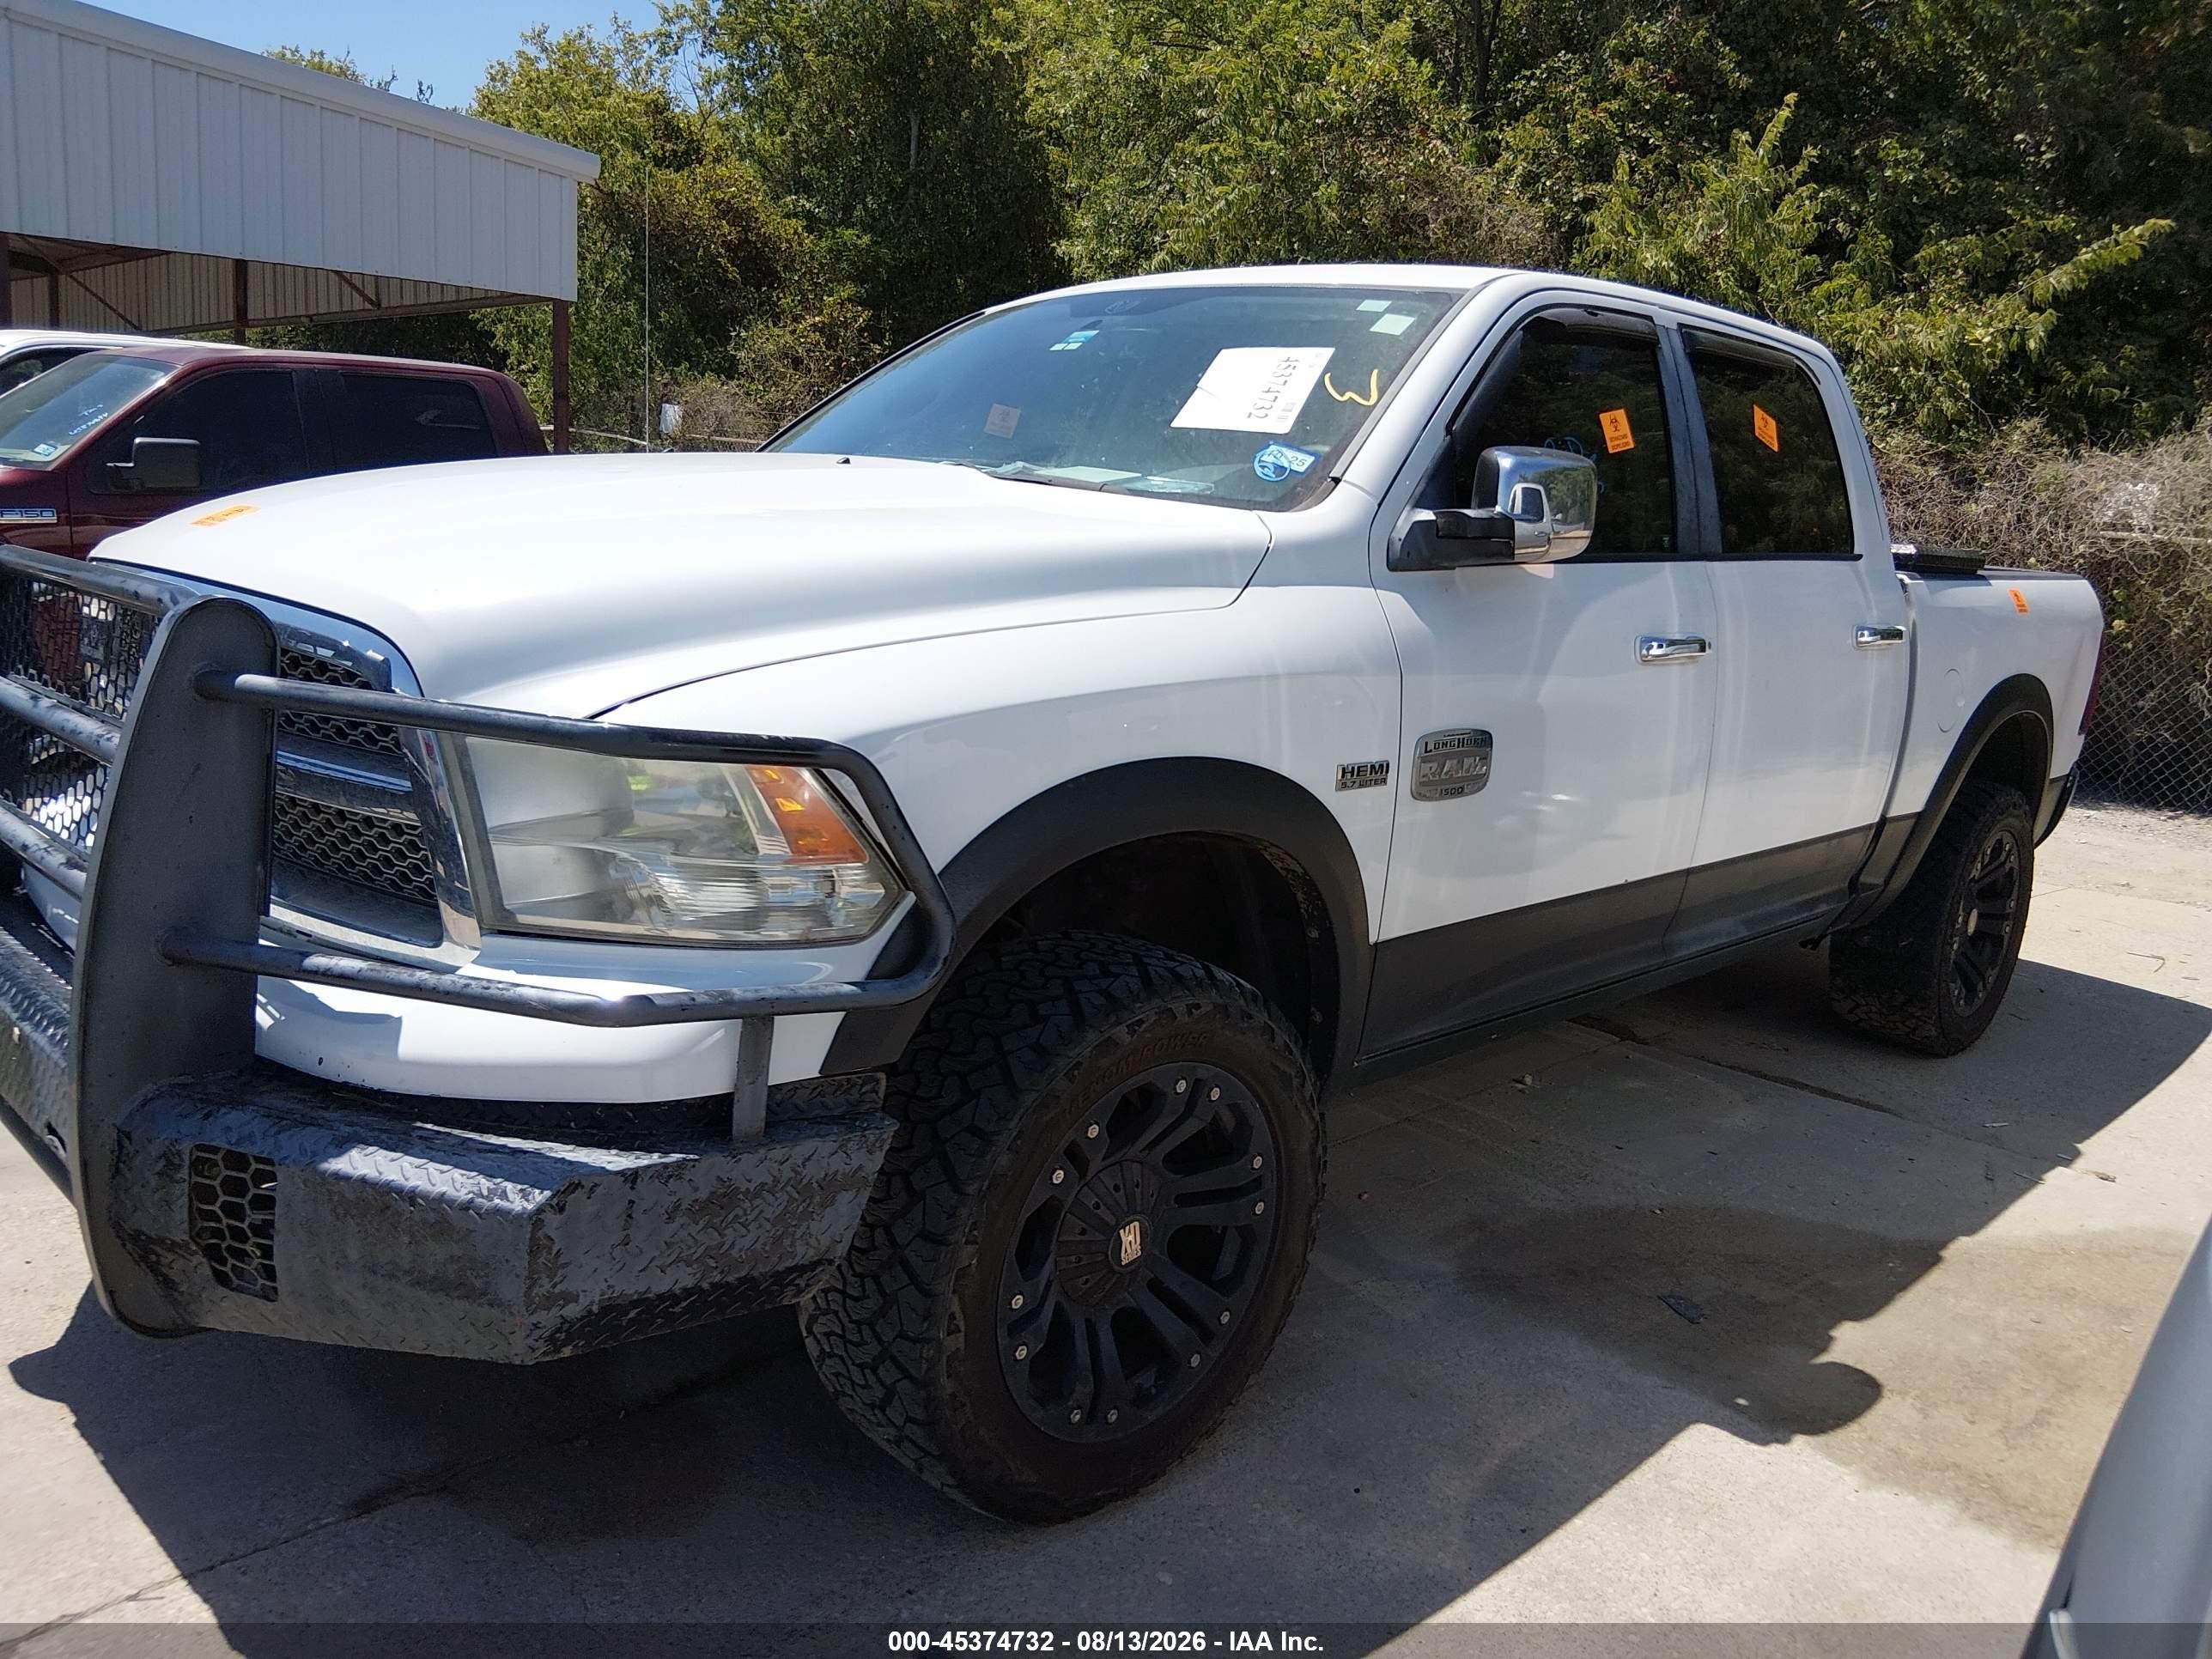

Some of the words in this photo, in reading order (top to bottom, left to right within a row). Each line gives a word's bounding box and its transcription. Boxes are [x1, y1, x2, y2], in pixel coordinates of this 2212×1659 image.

[1247, 356, 1299, 419] 45374732
[1340, 762, 1389, 779] HEMI
[1419, 757, 1487, 781] RAM
[1358, 778, 1387, 787] LITER
[1440, 786, 1464, 797] 1500
